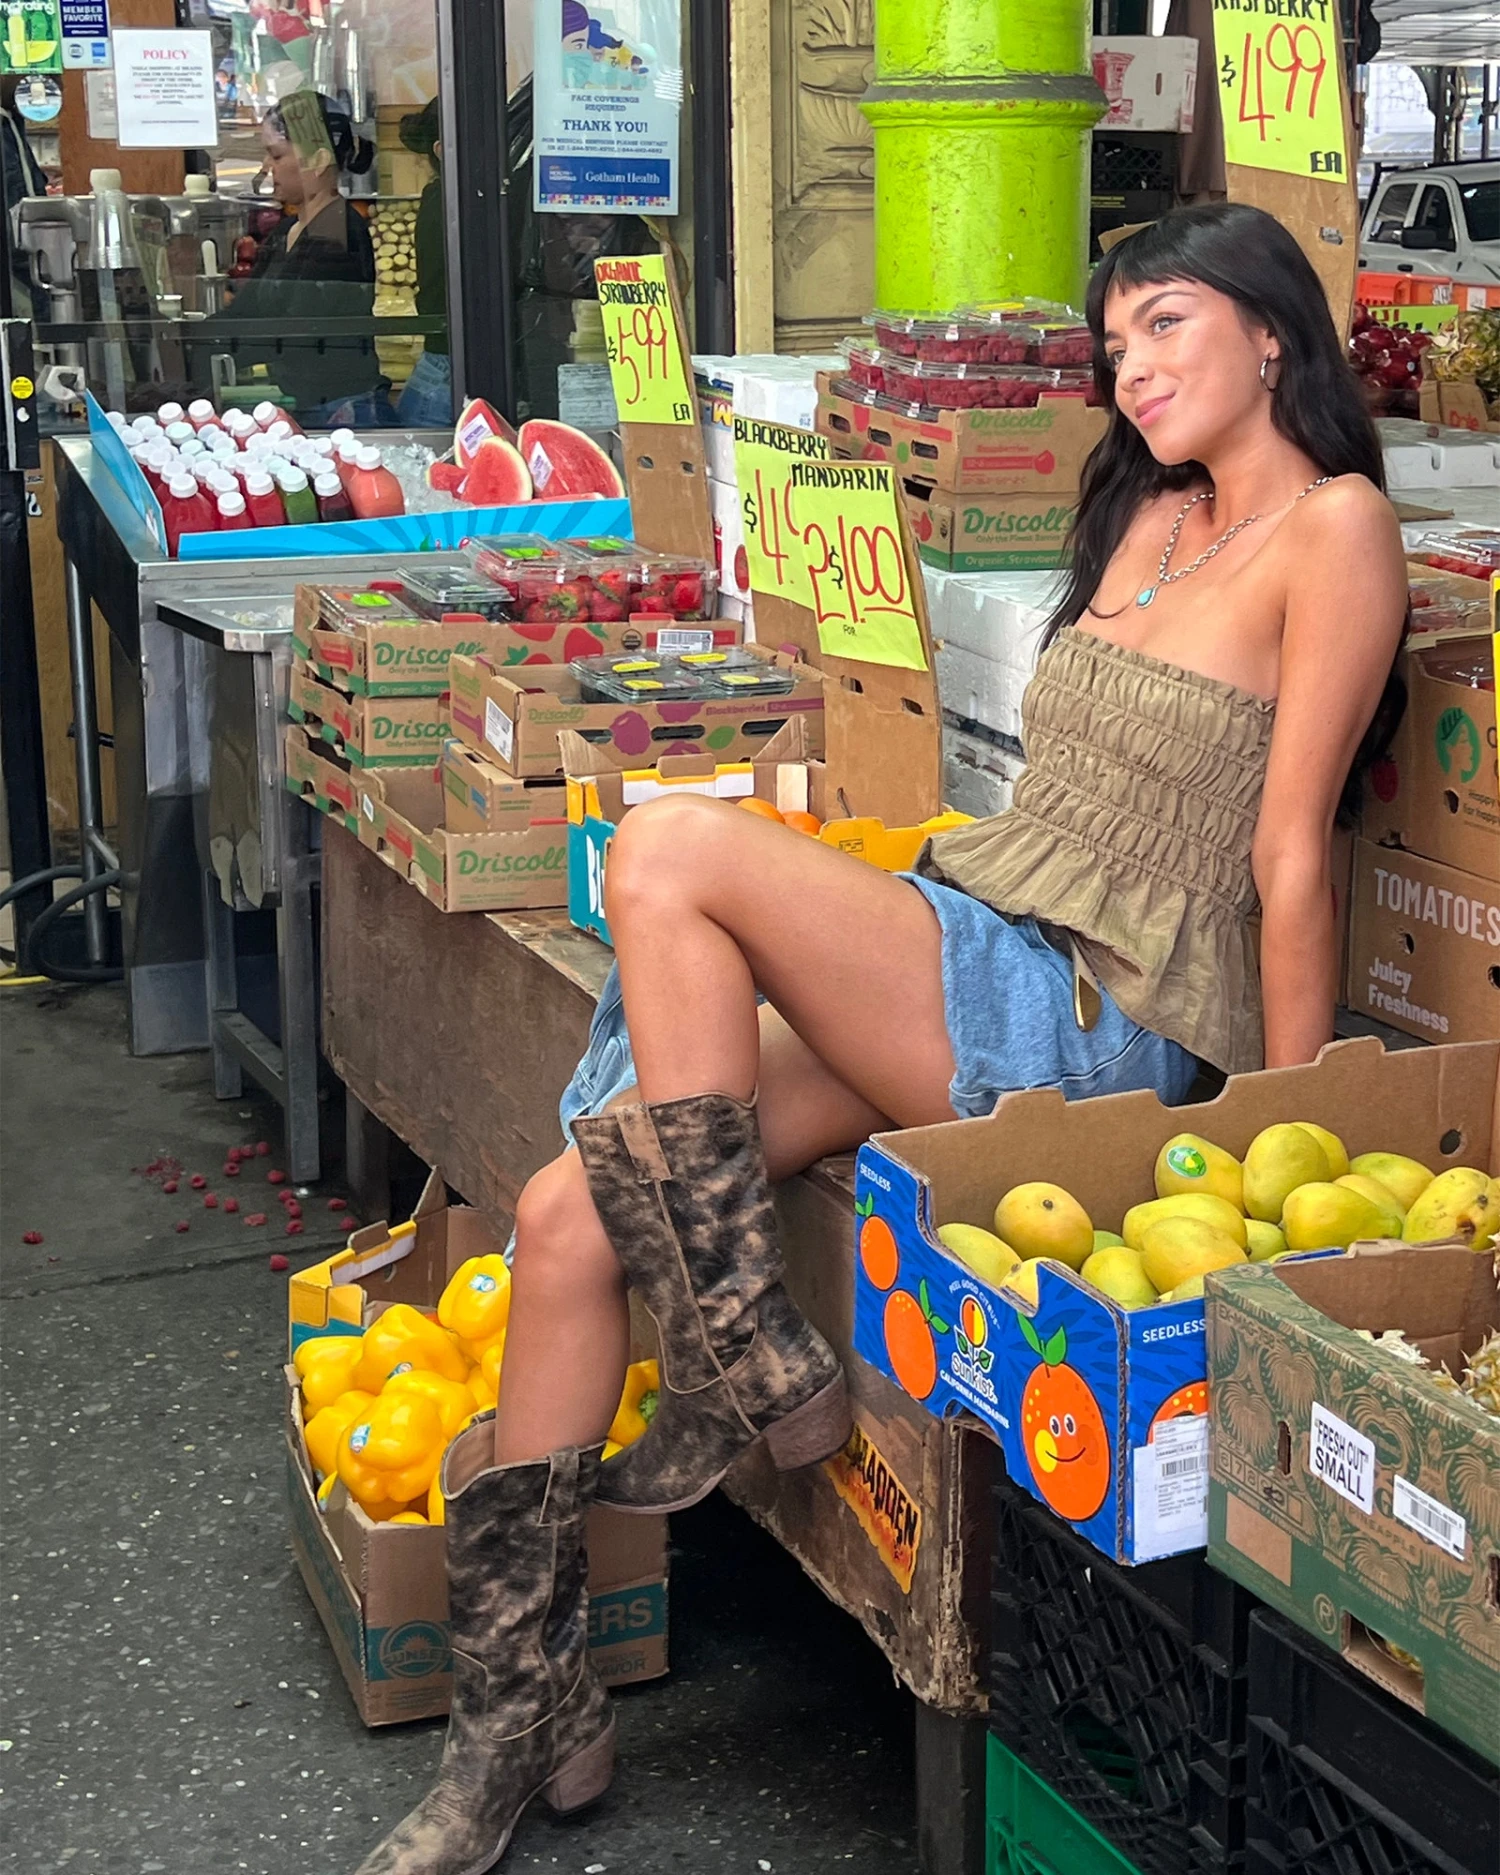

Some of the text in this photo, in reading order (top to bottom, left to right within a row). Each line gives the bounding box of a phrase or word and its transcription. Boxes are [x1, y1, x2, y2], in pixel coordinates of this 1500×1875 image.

[63, 14, 104, 22] FAVORITE
[143, 49, 188, 60] POLICY
[563, 119, 648, 133] THANK YOU!
[1311, 151, 1342, 174] EA
[585, 171, 660, 184] Gotham Health
[673, 403, 690, 421] EA
[734, 418, 827, 460] BLACKBERRY
[791, 463, 890, 493] MANDARIN
[456, 846, 568, 876] Driscoll
[1374, 867, 1500, 947] TOMATOES
[1369, 957, 1412, 994] Juicy
[1368, 984, 1449, 1034] Freshness
[860, 1163, 891, 1192] SEEDLESS
[1142, 1318, 1207, 1343] SEEDLESS
[951, 1352, 993, 1400] Sunkist
[1315, 1446, 1366, 1502] SMALL
